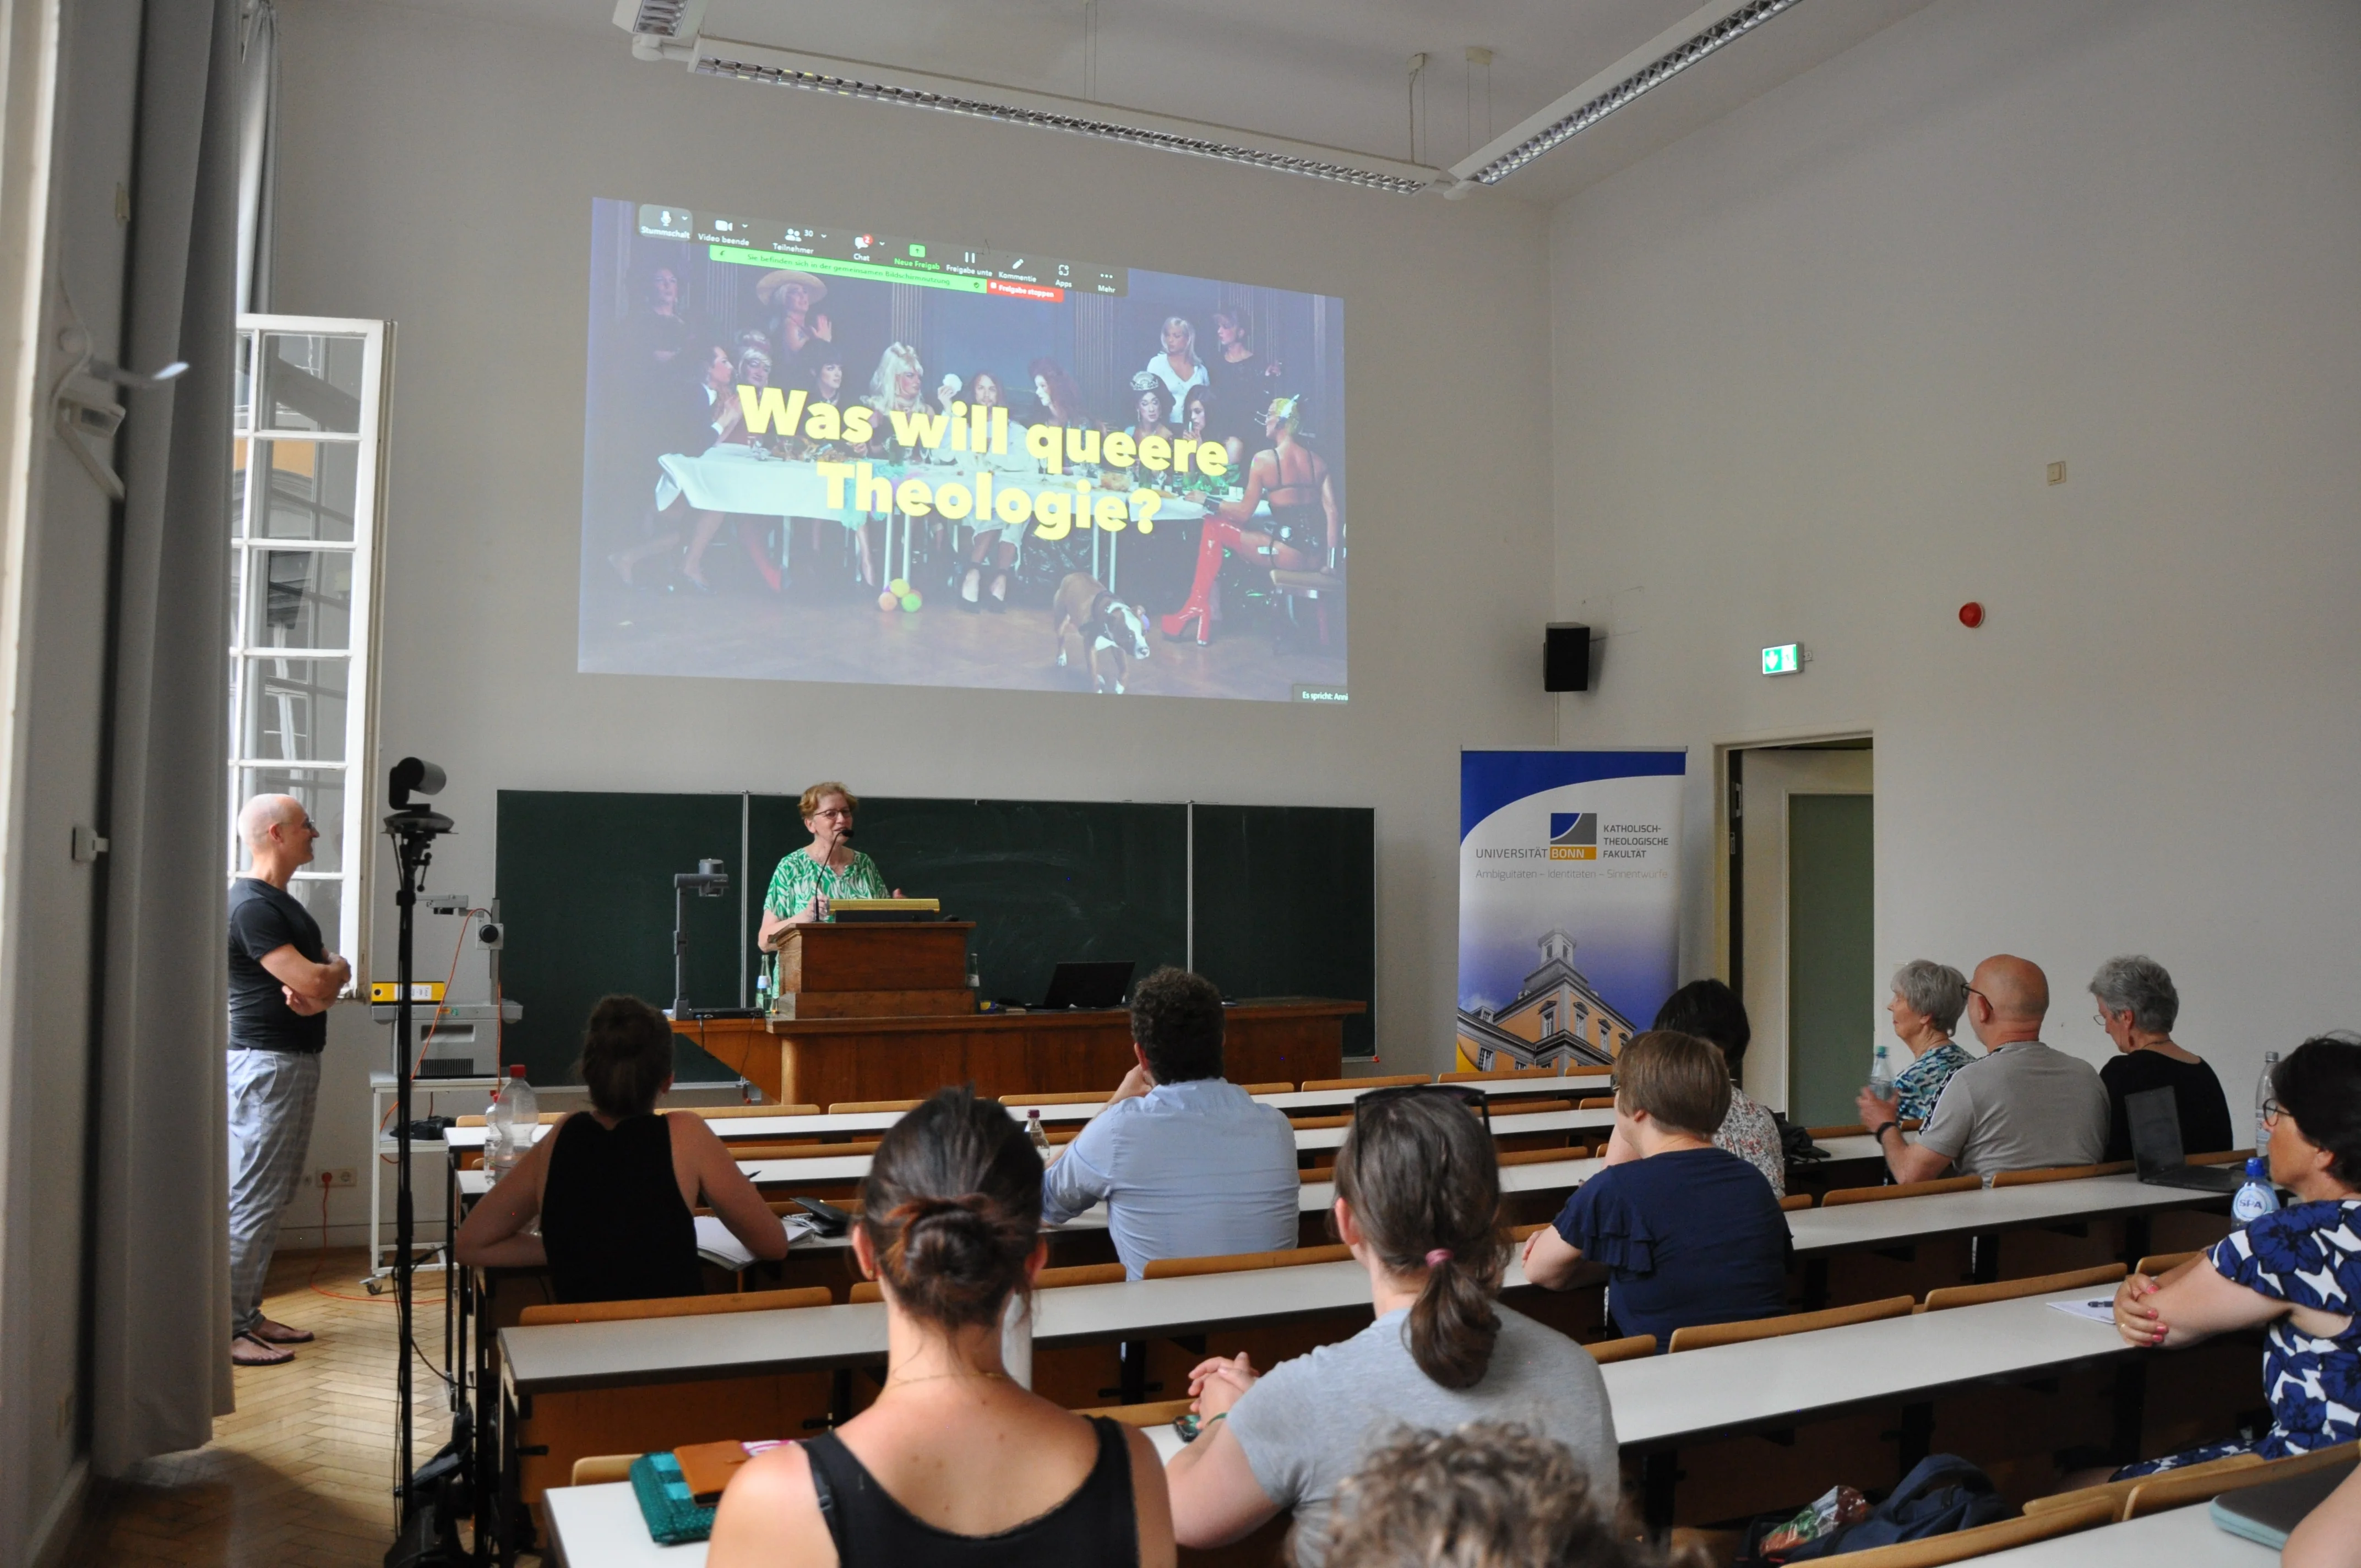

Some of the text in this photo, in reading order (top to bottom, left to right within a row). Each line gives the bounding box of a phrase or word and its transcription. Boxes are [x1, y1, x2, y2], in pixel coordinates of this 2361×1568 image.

[698, 233, 750, 246] Video beende
[864, 236, 871, 244] 2
[773, 243, 814, 254] Teilnehmer
[853, 253, 870, 262] Chat
[894, 258, 940, 270] Neue Freigab
[946, 264, 975, 275] Freigabe
[760, 256, 792, 265] befinden
[834, 265, 883, 276] gemeinsamen
[885, 271, 950, 285] Bildschirmnutzung
[999, 271, 1037, 282] Kommentie
[1056, 280, 1072, 288] Apps
[1098, 285, 1116, 293] Mehr
[999, 284, 1054, 298] Freigabe stoppen
[737, 385, 1229, 477] Was will queere
[817, 460, 1162, 541] Theologie?
[1476, 847, 1584, 858] UNIVERSITÄT BONN
[1603, 848, 1646, 858] FAKULTÄT
[1476, 870, 1537, 881] Ambiguitäten
[2239, 1199, 2262, 1210] SPA
